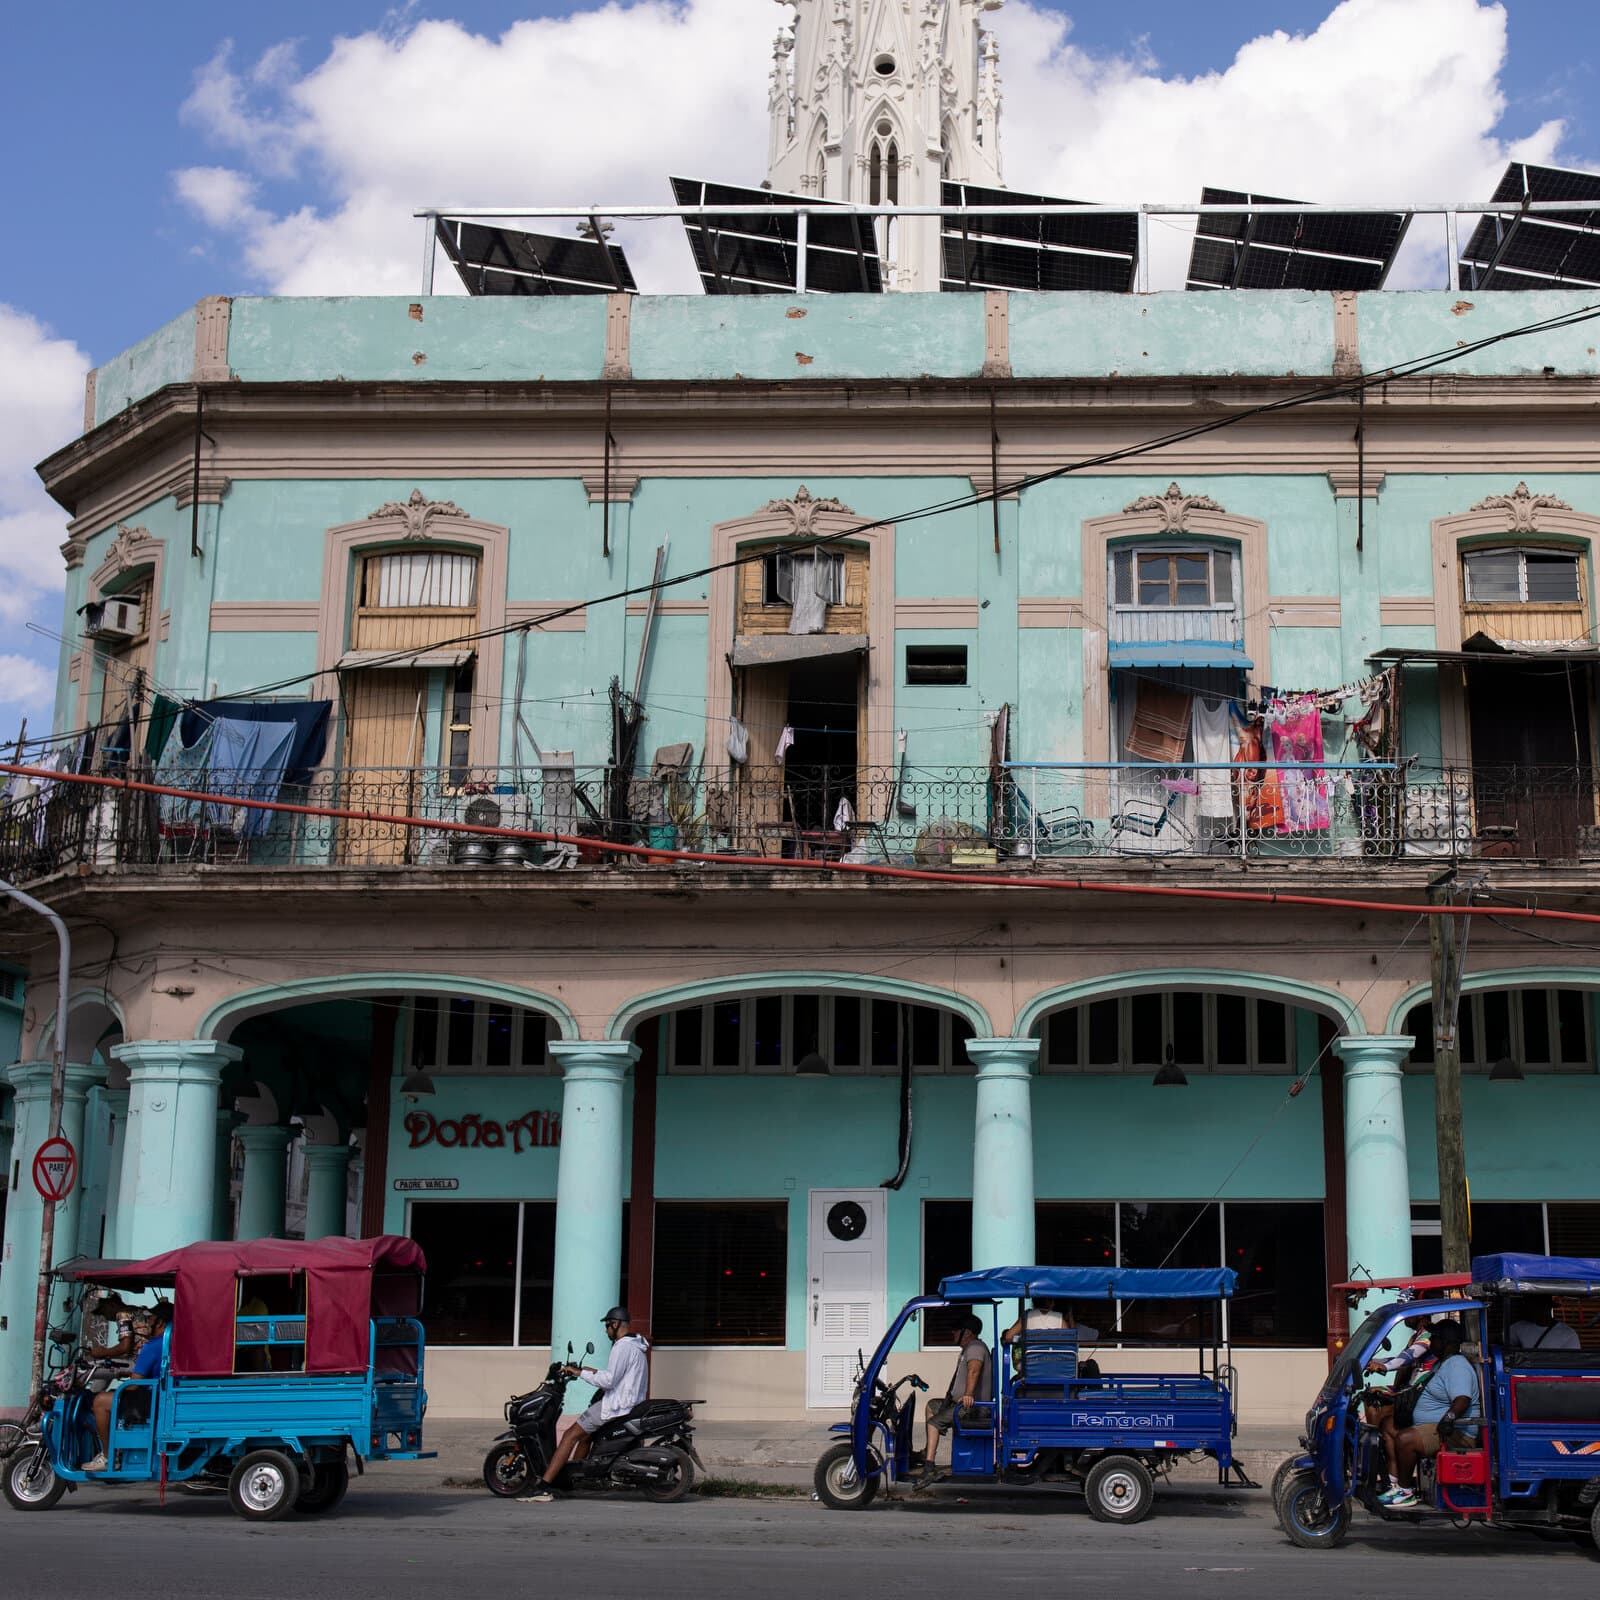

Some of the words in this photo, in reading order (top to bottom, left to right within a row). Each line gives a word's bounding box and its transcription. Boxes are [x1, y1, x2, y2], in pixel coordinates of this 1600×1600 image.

[404, 1111, 504, 1149] Doña
[506, 1110, 562, 1153] Ali
[49, 1163, 64, 1172] PARE
[1072, 1413, 1174, 1429] Fengchi
